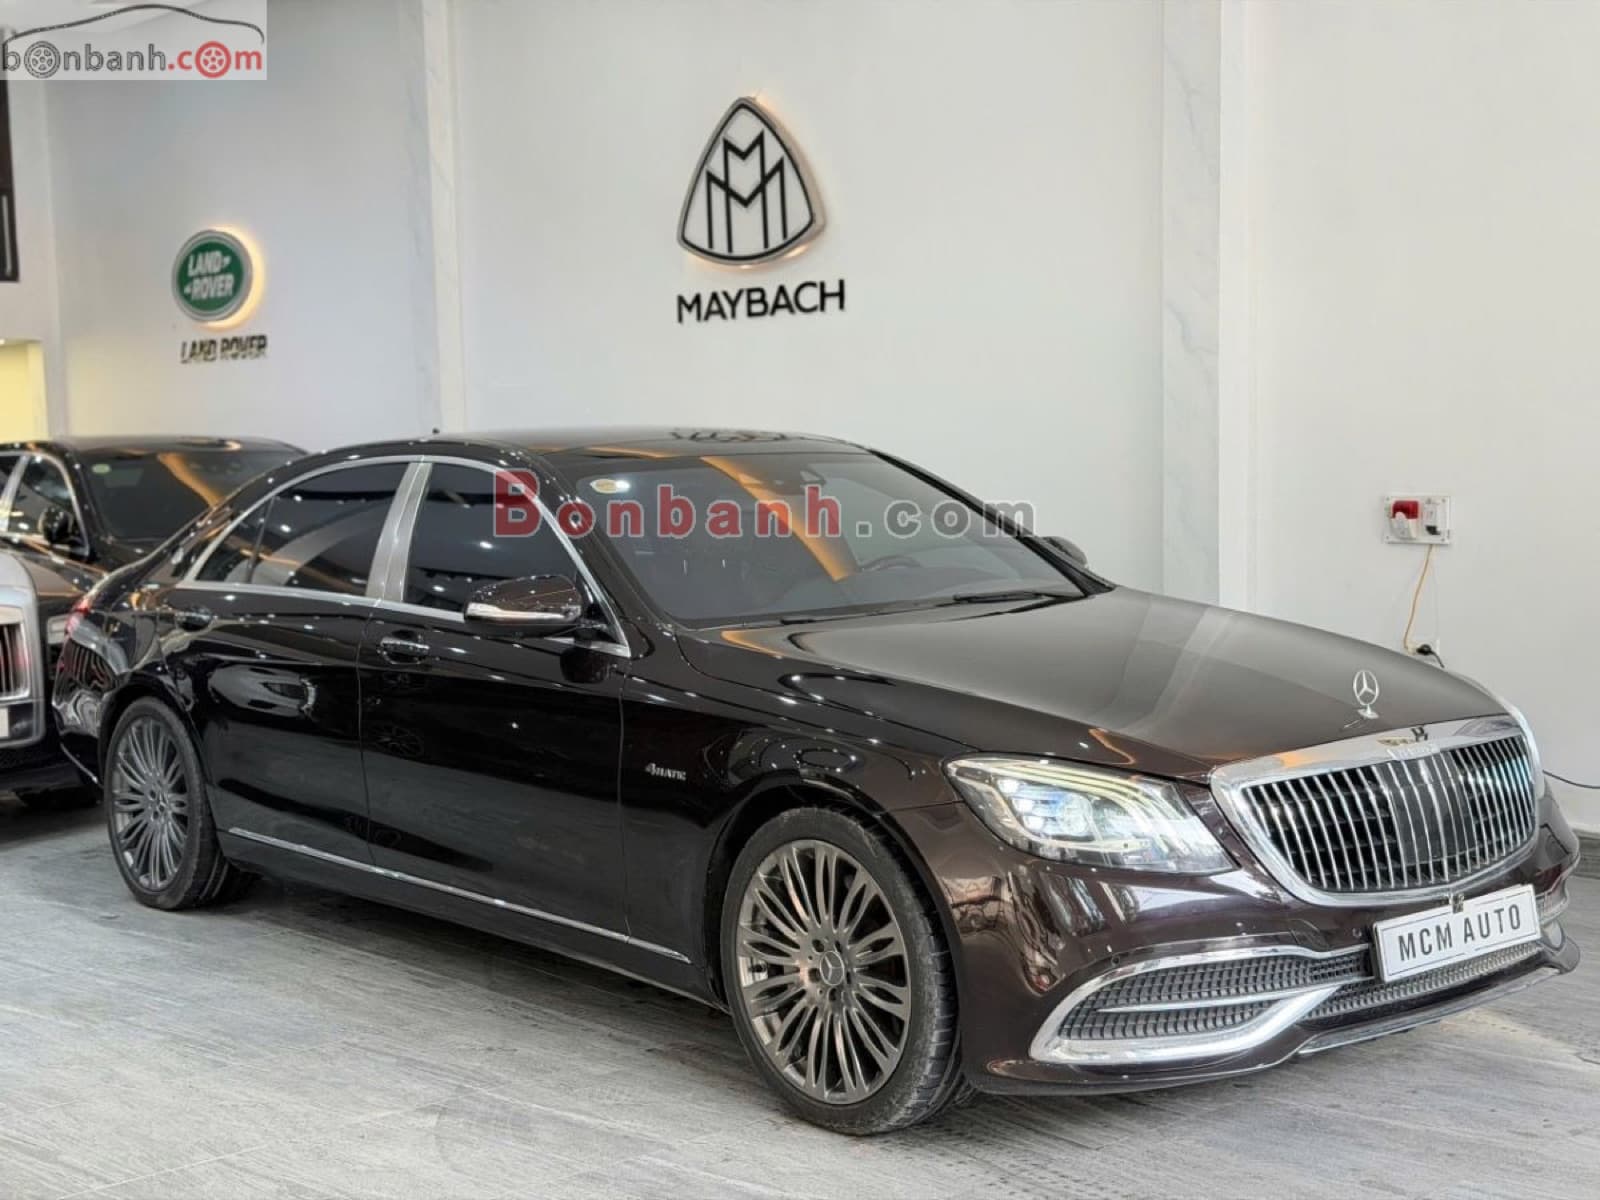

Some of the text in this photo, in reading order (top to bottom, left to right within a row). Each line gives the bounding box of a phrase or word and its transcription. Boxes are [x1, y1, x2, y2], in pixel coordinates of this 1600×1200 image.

[187, 250, 223, 277] LAND
[191, 273, 235, 300] ROVER
[676, 278, 846, 324] MAYBACH
[180, 334, 268, 364] LAND ROVER
[1398, 903, 1522, 962] MCM AUTO
